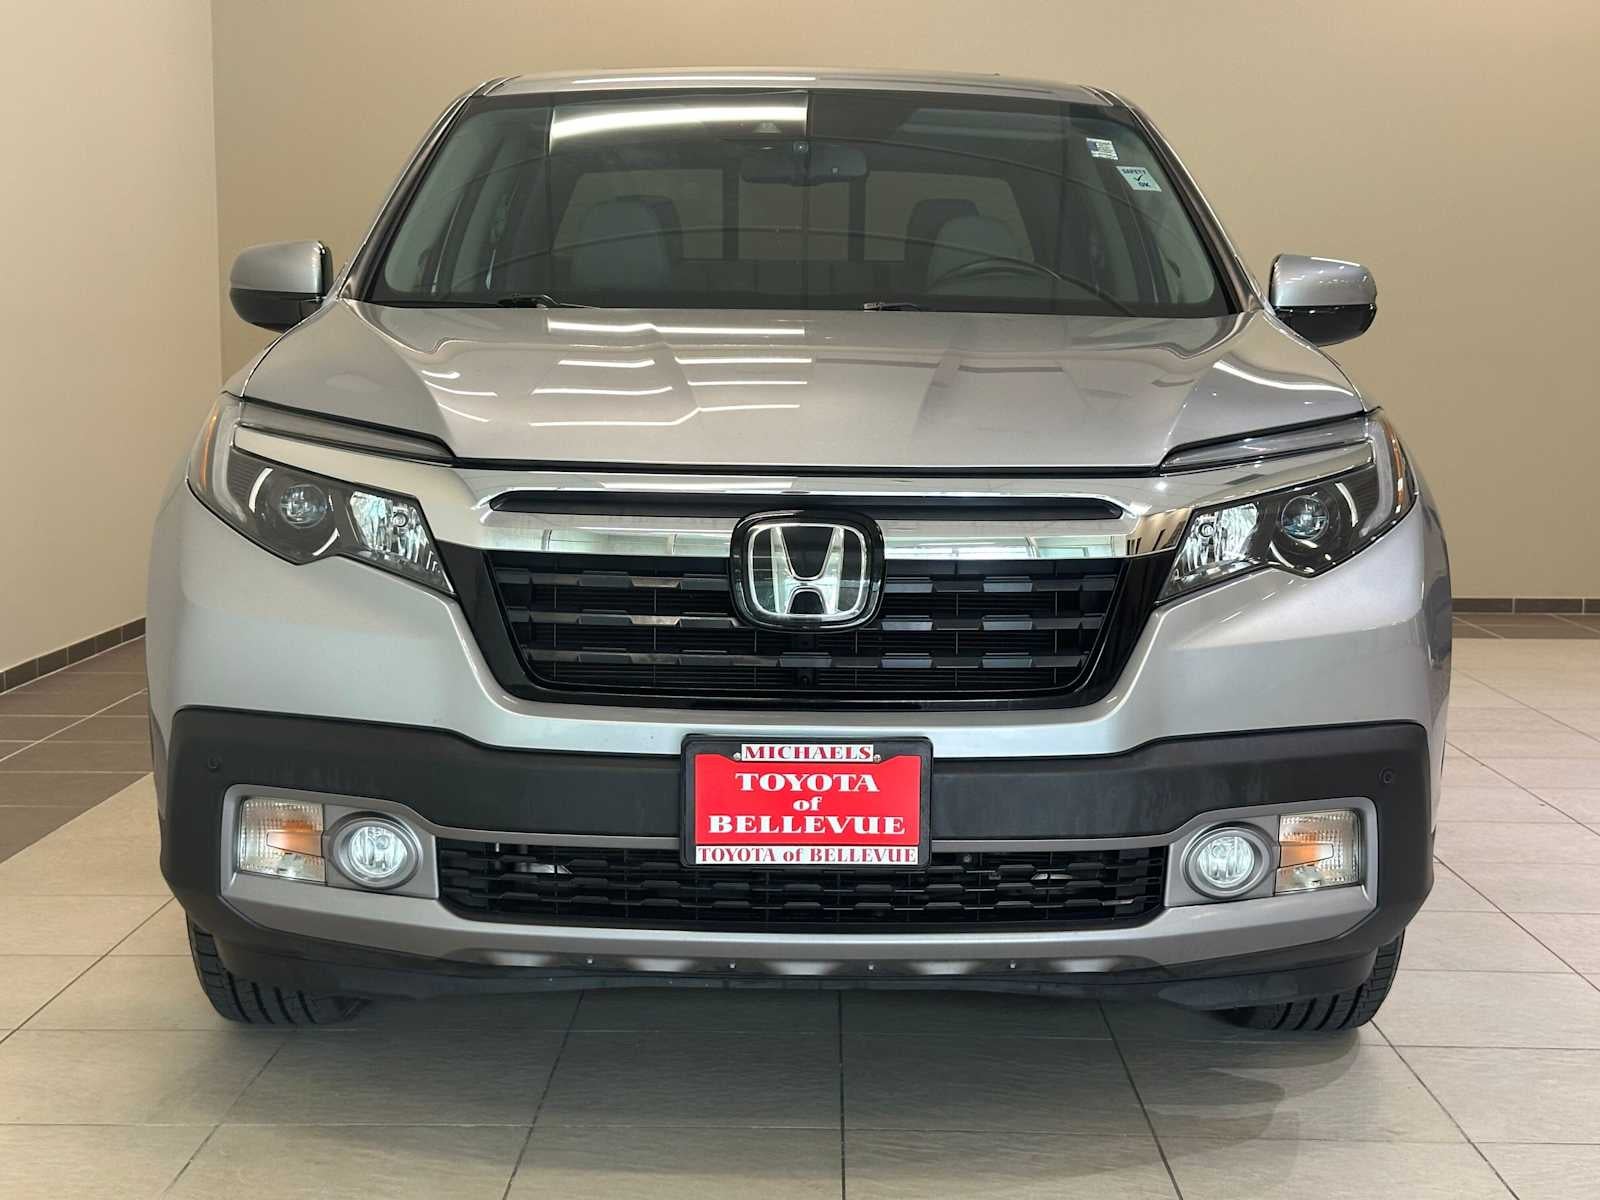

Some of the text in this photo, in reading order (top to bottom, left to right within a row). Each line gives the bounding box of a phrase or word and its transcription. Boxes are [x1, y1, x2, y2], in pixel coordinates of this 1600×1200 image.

[744, 745, 872, 761] MICHAELS
[735, 772, 880, 792] TOYOTA
[792, 796, 822, 812] of
[708, 815, 905, 835] BELLEVUE
[698, 847, 916, 863] TOYOTA of BELLEVUE
